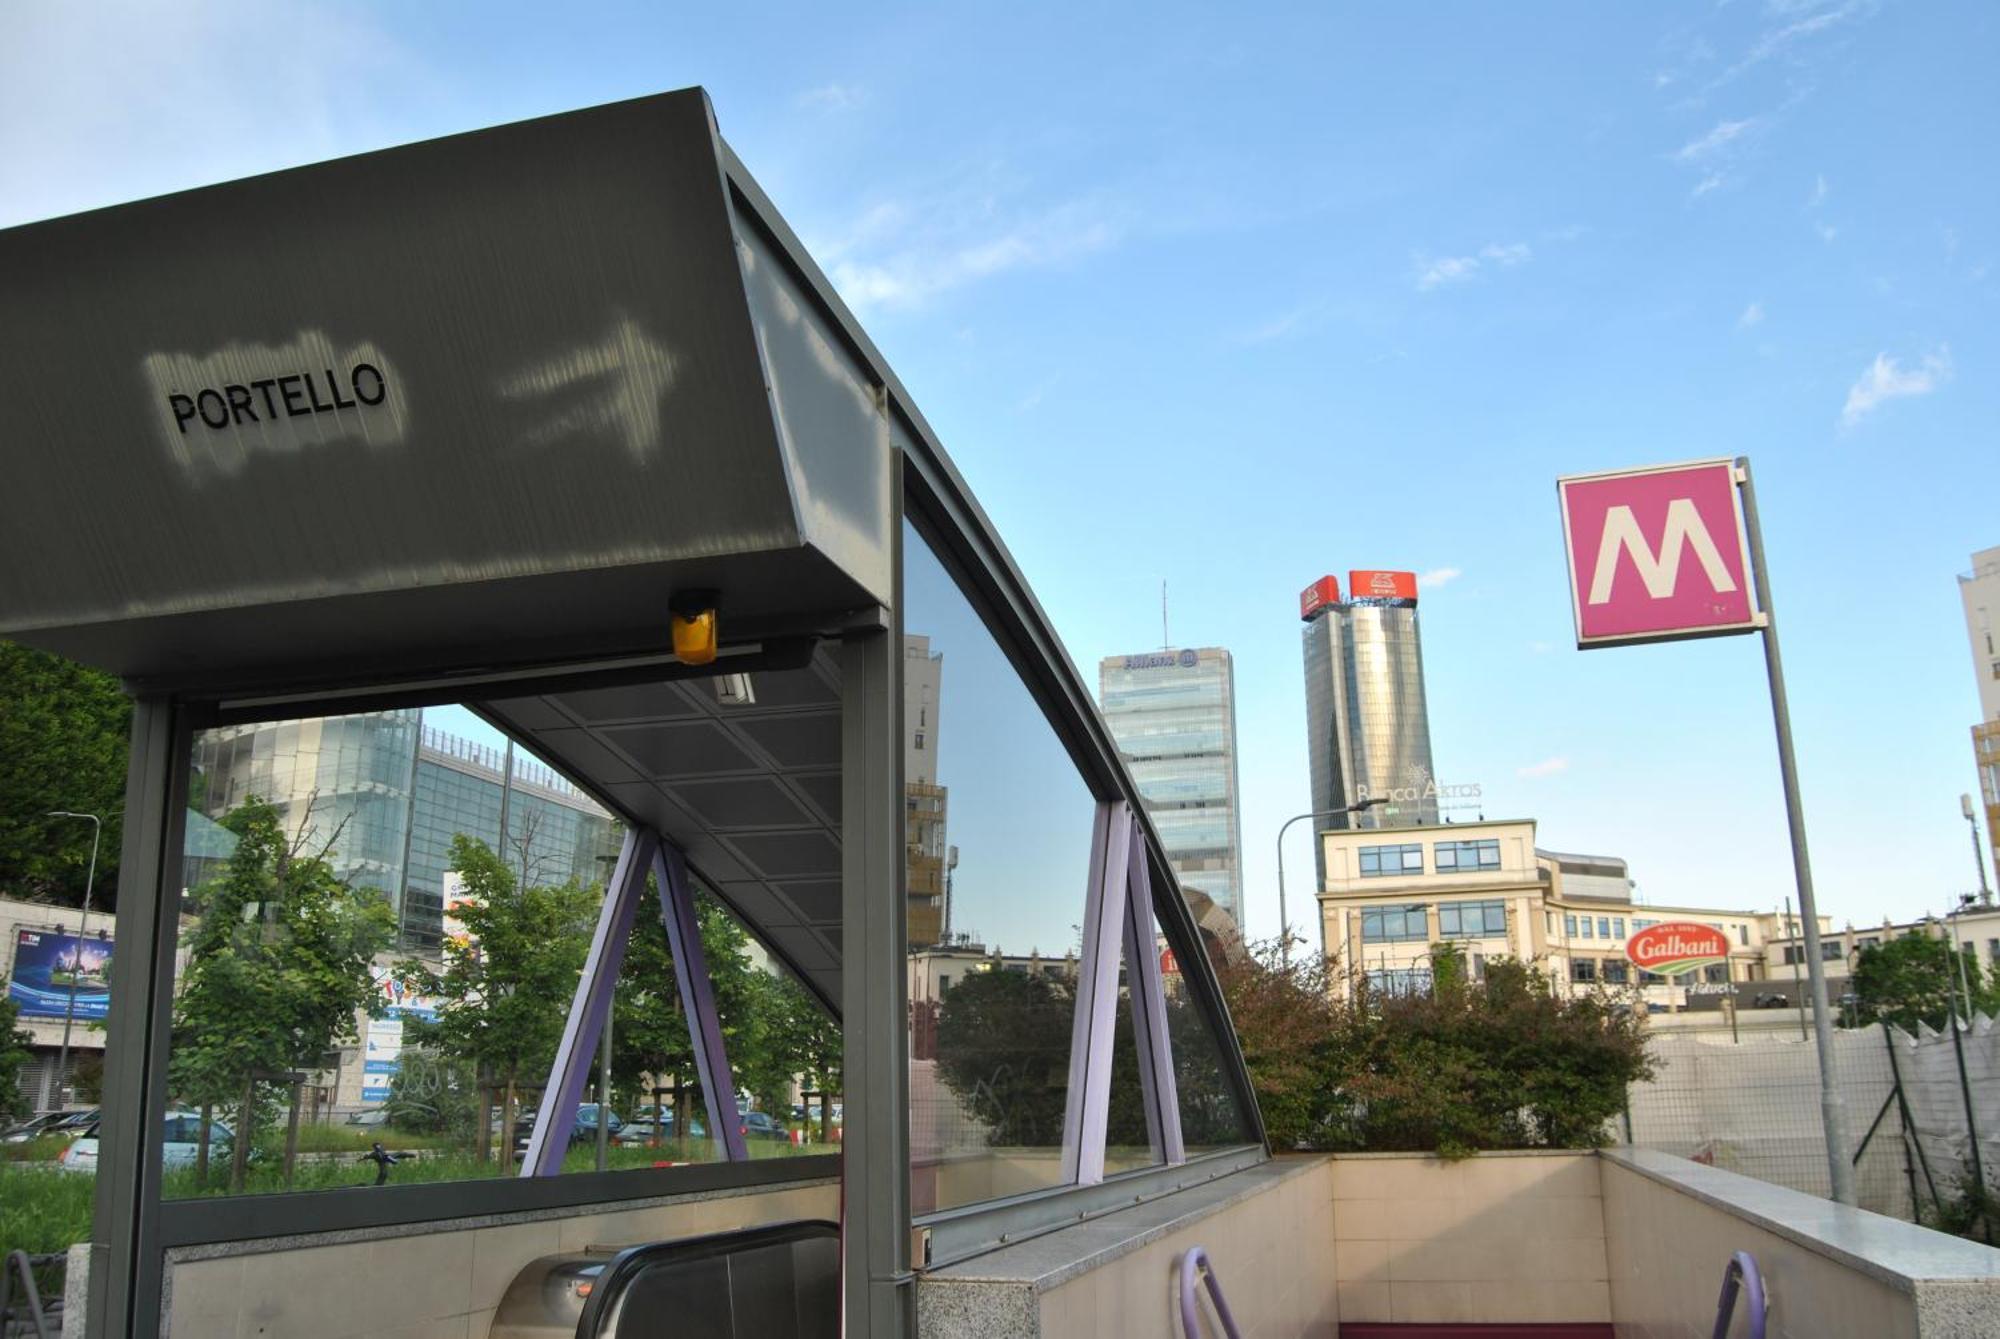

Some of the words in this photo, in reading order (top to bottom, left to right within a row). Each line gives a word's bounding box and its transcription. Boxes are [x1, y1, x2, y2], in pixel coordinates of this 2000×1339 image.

[169, 363, 386, 434] PORTELLO
[1588, 498, 1738, 605] M
[1123, 654, 1176, 670] Allianz
[1636, 934, 1720, 960] Galbani
